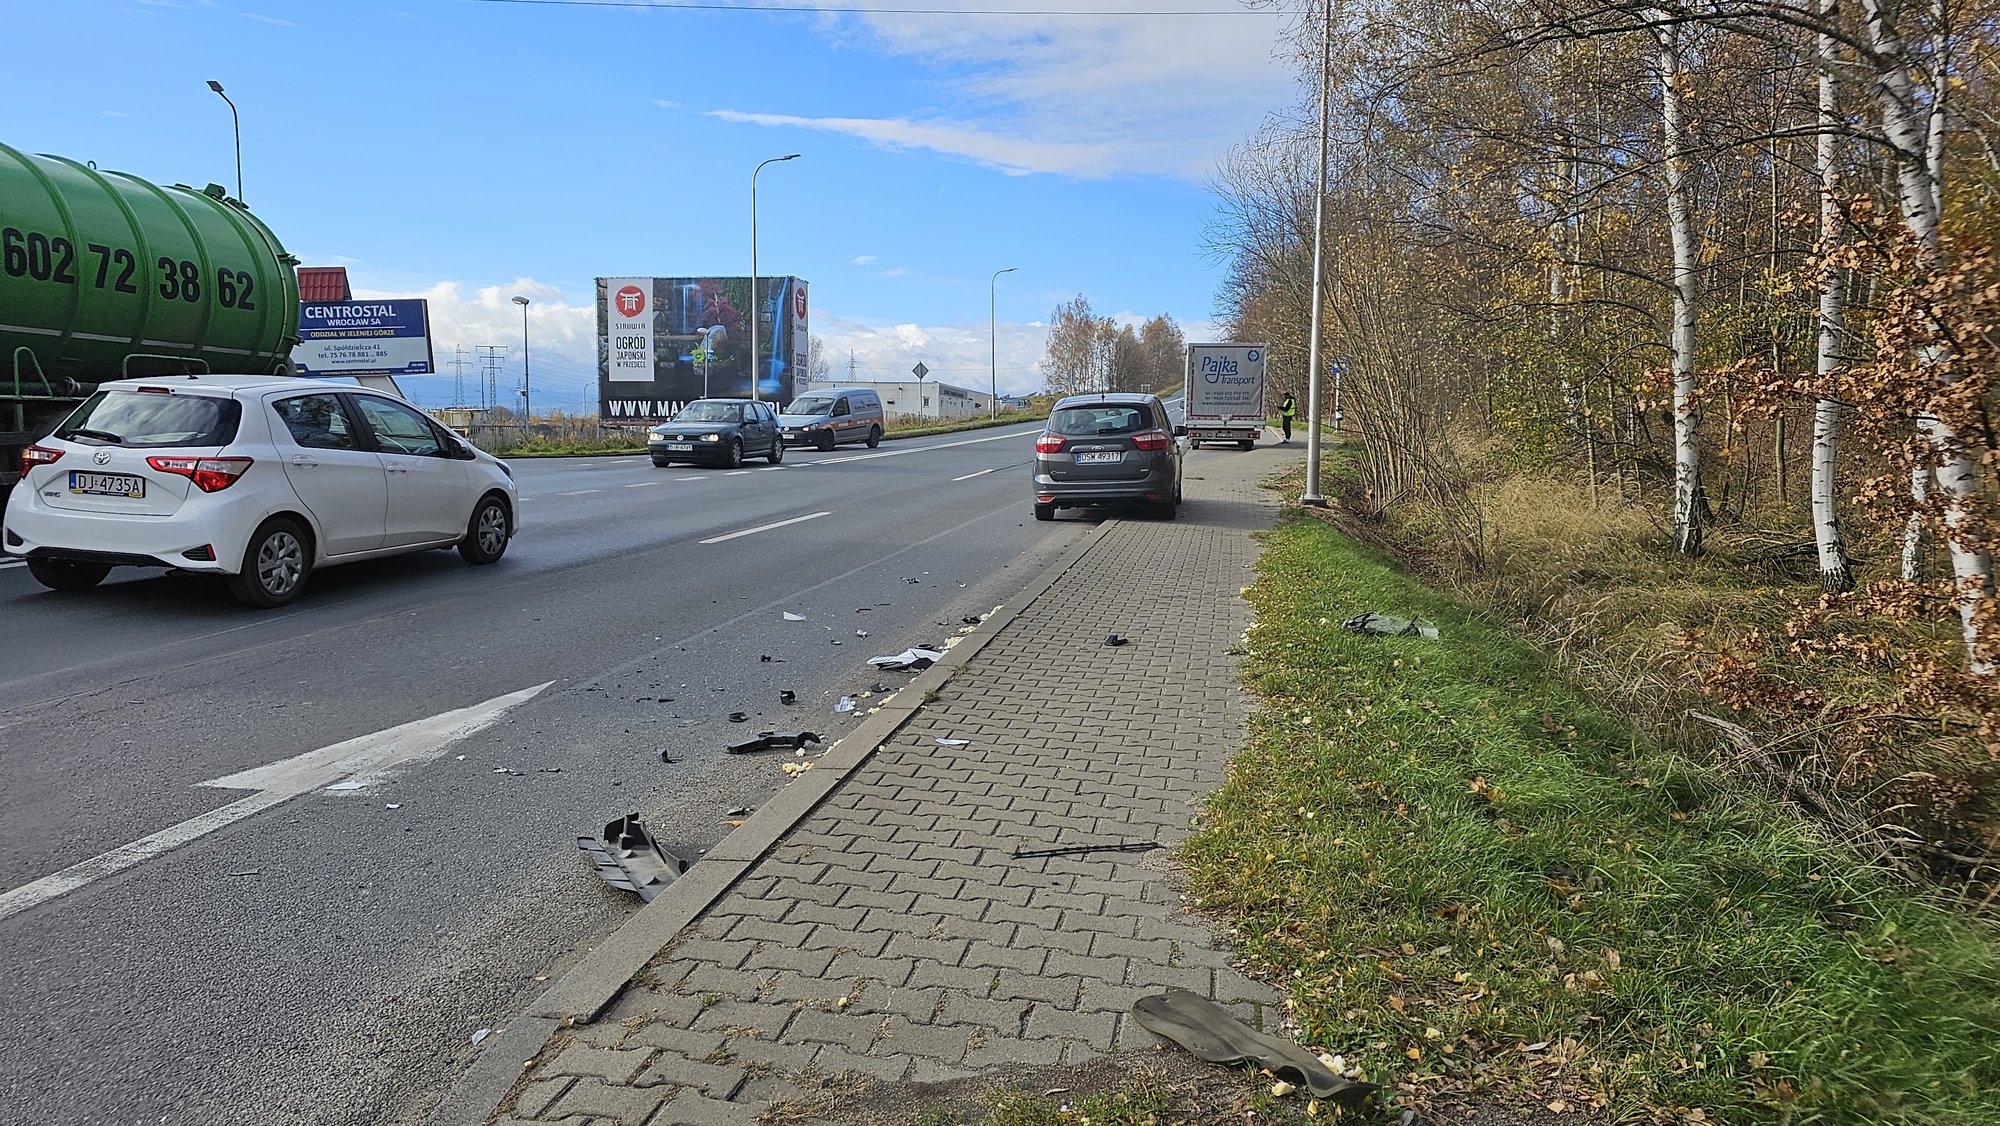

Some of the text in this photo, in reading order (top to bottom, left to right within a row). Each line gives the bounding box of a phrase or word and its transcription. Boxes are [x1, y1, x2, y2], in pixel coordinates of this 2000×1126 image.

[2, 228, 254, 310] 602 72 38 62
[305, 304, 396, 318] CENTROSTAL
[327, 318, 368, 326] WROCŁAW
[616, 334, 646, 349] OGRÓD
[616, 350, 646, 360] JAPOŃSKI
[1201, 356, 1238, 383] Pajka
[1220, 375, 1254, 386] Transport
[78, 475, 140, 493] DJ 4735A
